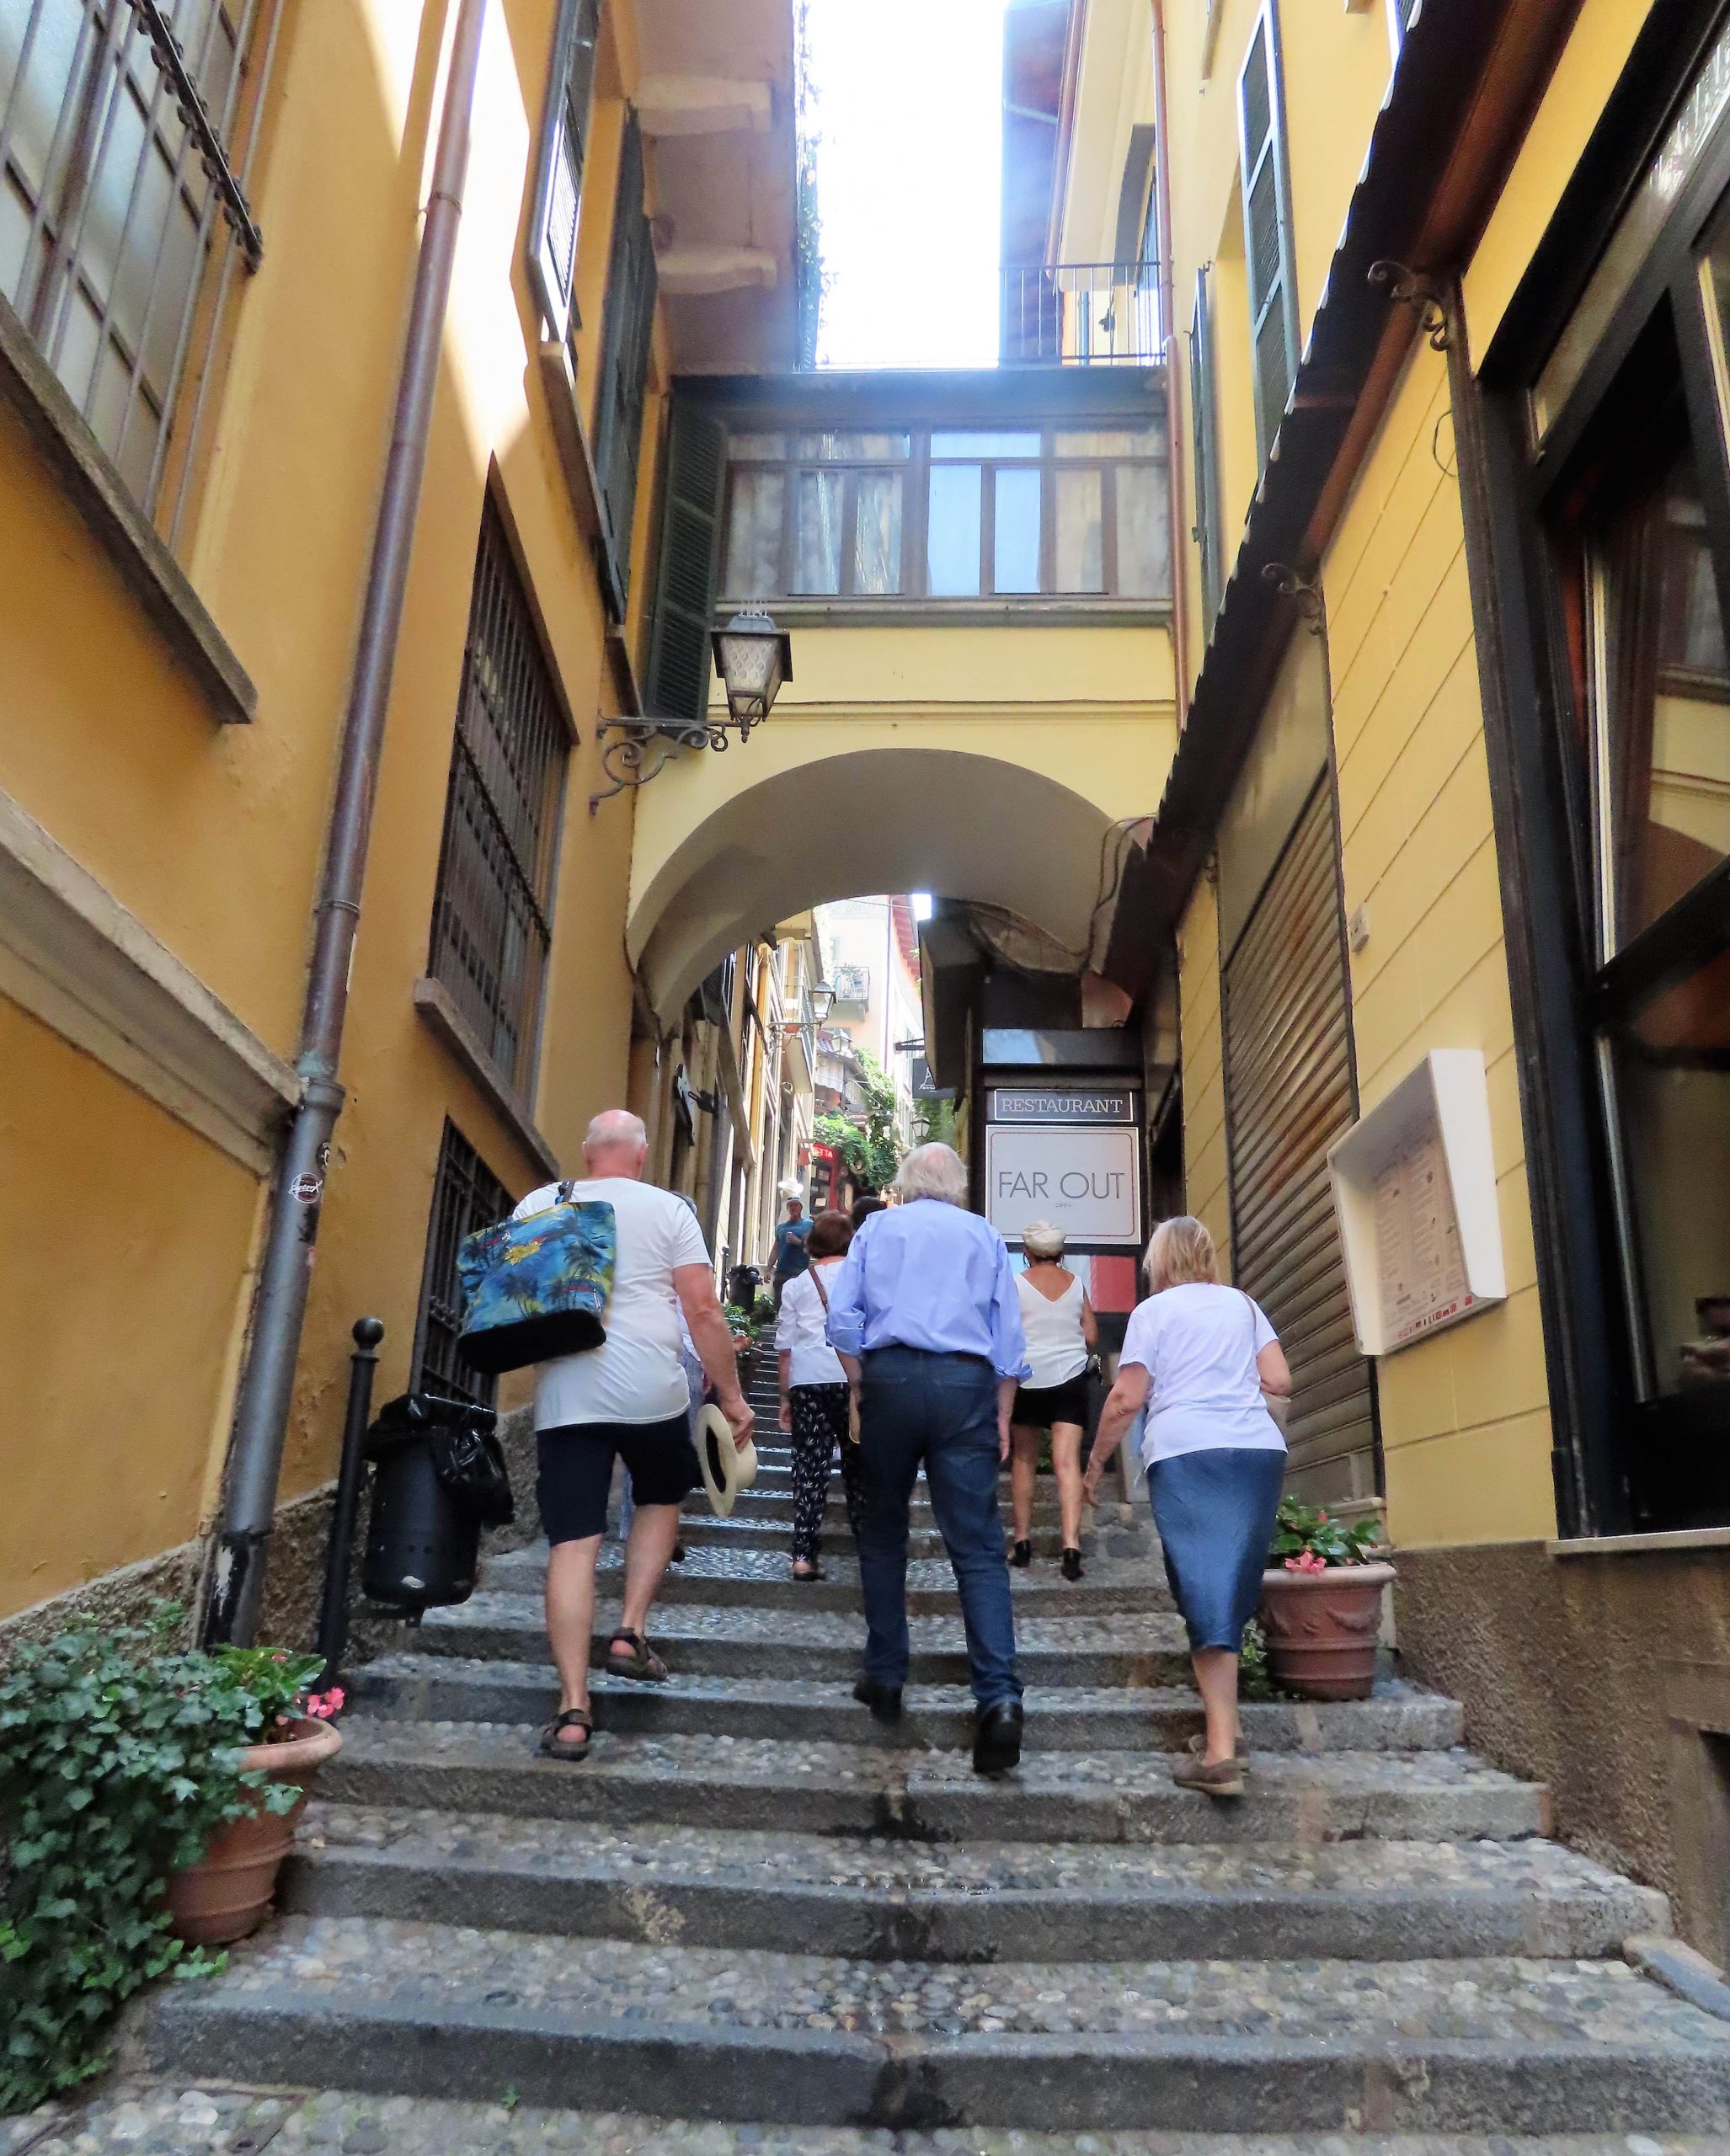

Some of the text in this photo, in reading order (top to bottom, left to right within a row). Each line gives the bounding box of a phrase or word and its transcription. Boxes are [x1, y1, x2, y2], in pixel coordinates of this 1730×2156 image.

[1001, 1097, 1124, 1113] RESTAURANT
[998, 1171, 1125, 1199] FAR OUT
